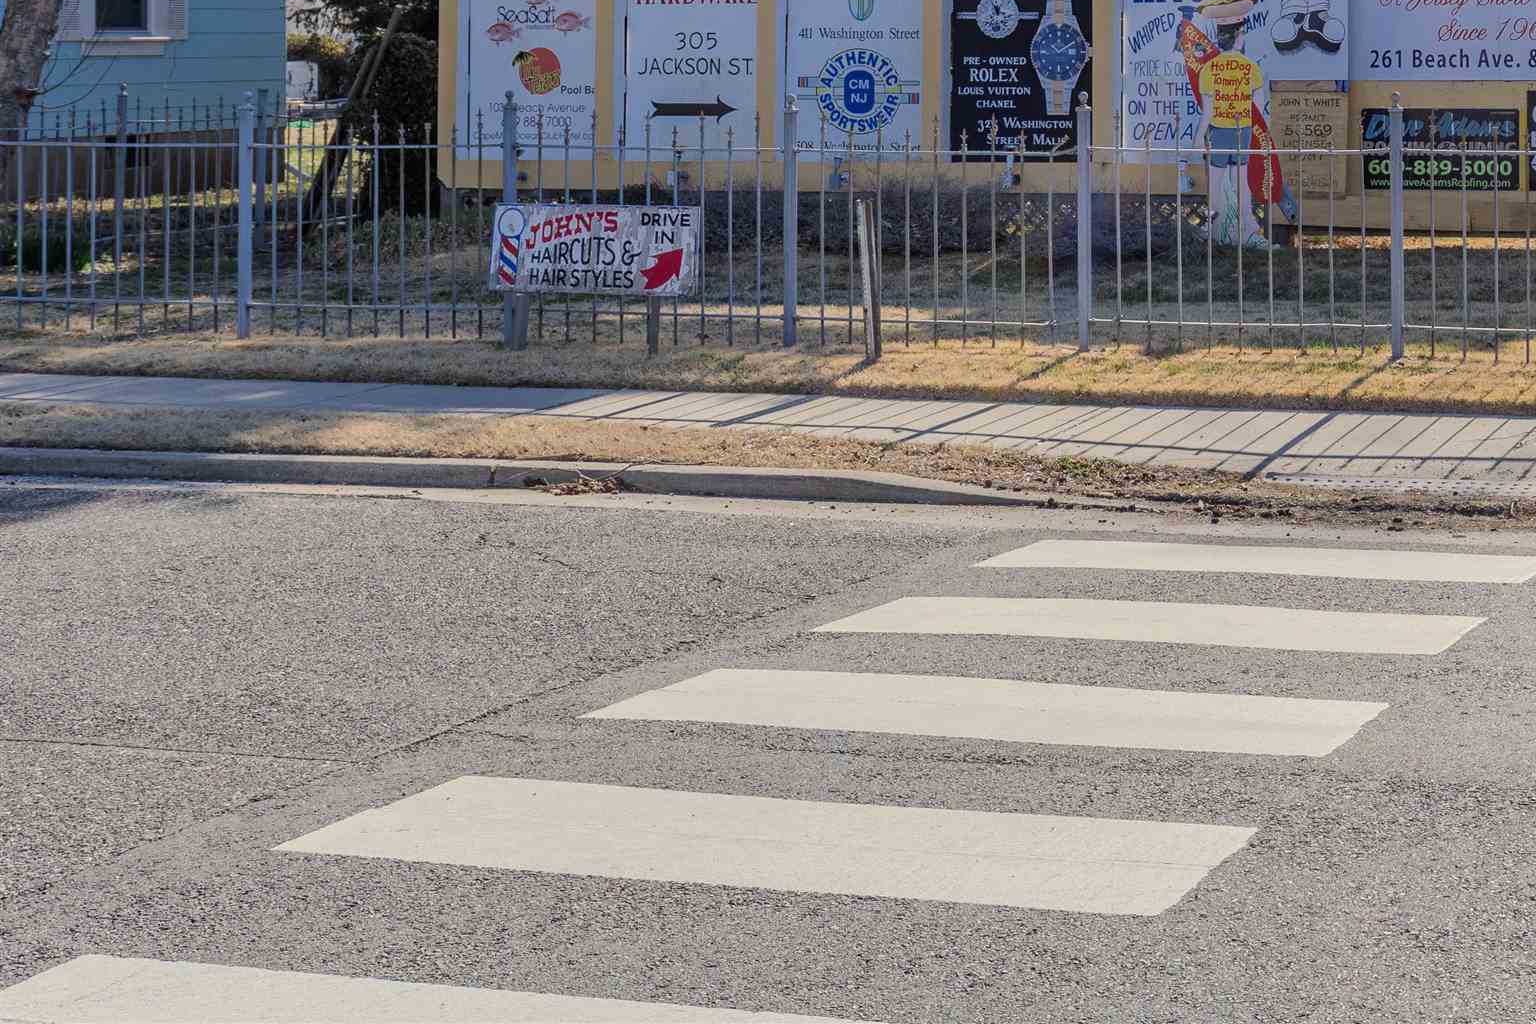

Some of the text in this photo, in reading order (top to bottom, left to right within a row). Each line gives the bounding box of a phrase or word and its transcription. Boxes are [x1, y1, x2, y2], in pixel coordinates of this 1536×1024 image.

[819, 27, 921, 42] Washington Street
[1128, 12, 1176, 54] WHIPPED
[1438, 18, 1487, 43] Since
[674, 32, 718, 50] 305
[1370, 49, 1402, 68] 261
[1412, 49, 1470, 68] Beach
[1478, 49, 1521, 68] Ave.
[638, 57, 753, 76] JACKSON ST.
[820, 52, 898, 87] AUTHENTIC
[970, 68, 1019, 82] ROLEX
[560, 85, 581, 95] Pool
[849, 80, 870, 89] CM
[958, 86, 1031, 96] LOUIS VUITTON
[1138, 82, 1159, 97] ON
[850, 94, 867, 103] NJ
[976, 100, 1016, 109] CHANEL
[1312, 98, 1341, 108] WHITE
[547, 103, 585, 113] Avenue
[820, 93, 898, 132] SPORTSWEAR
[1128, 100, 1147, 115] ON
[1133, 123, 1177, 142] OPEN
[525, 210, 691, 249] JOHN'S DRIVE
[654, 231, 674, 244] IN
[531, 237, 642, 266] HAIRCUTS &
